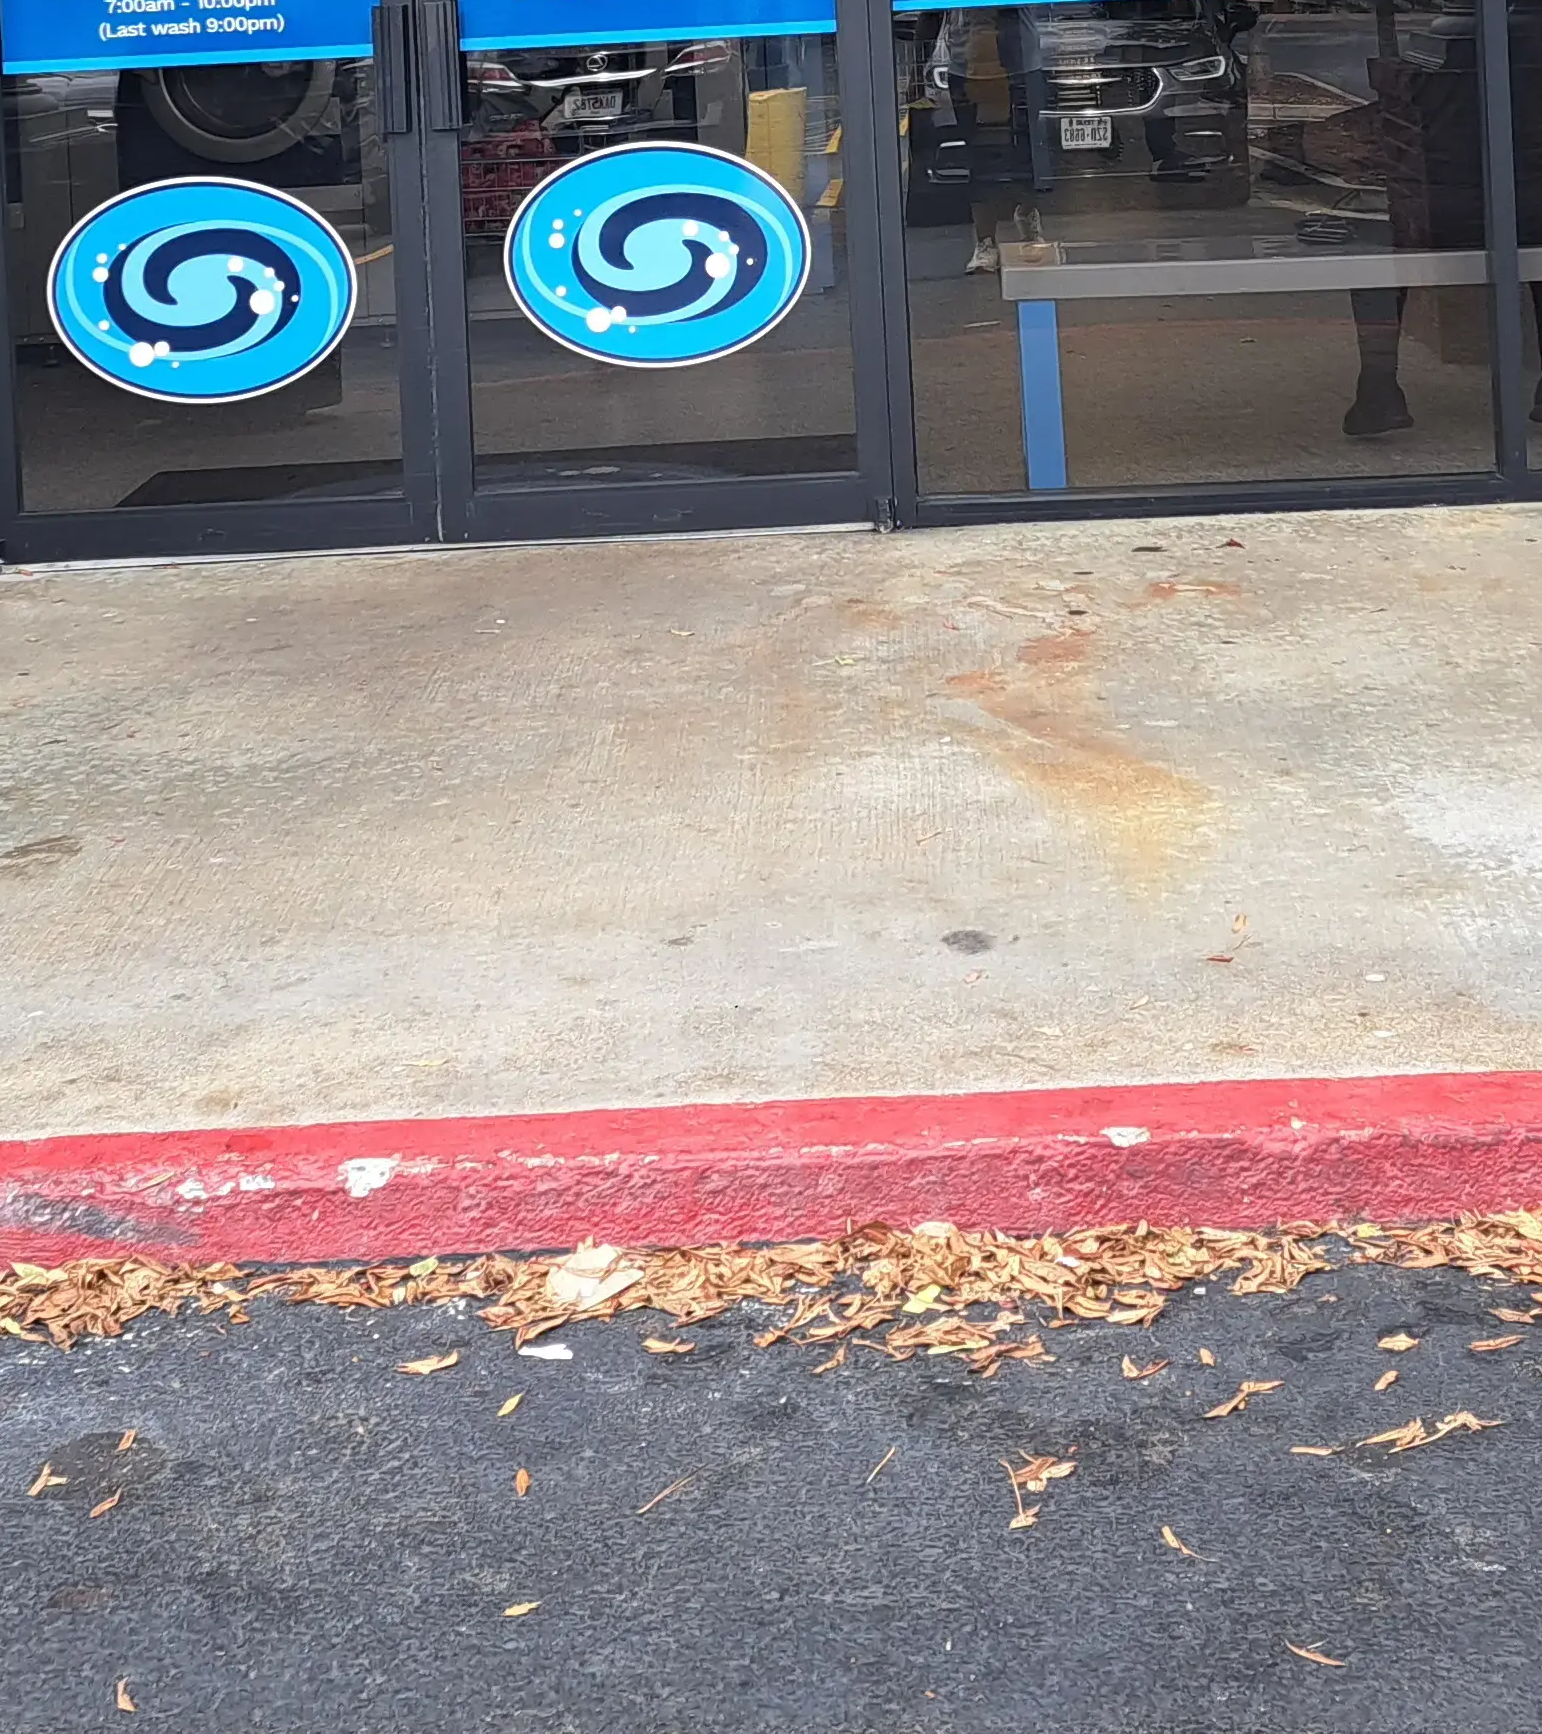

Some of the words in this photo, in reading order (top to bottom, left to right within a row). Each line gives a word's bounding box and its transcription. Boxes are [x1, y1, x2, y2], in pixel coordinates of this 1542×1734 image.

[98, 20, 147, 42] (Last
[151, 16, 201, 34] wash
[206, 12, 285, 36] 9:00pm)
